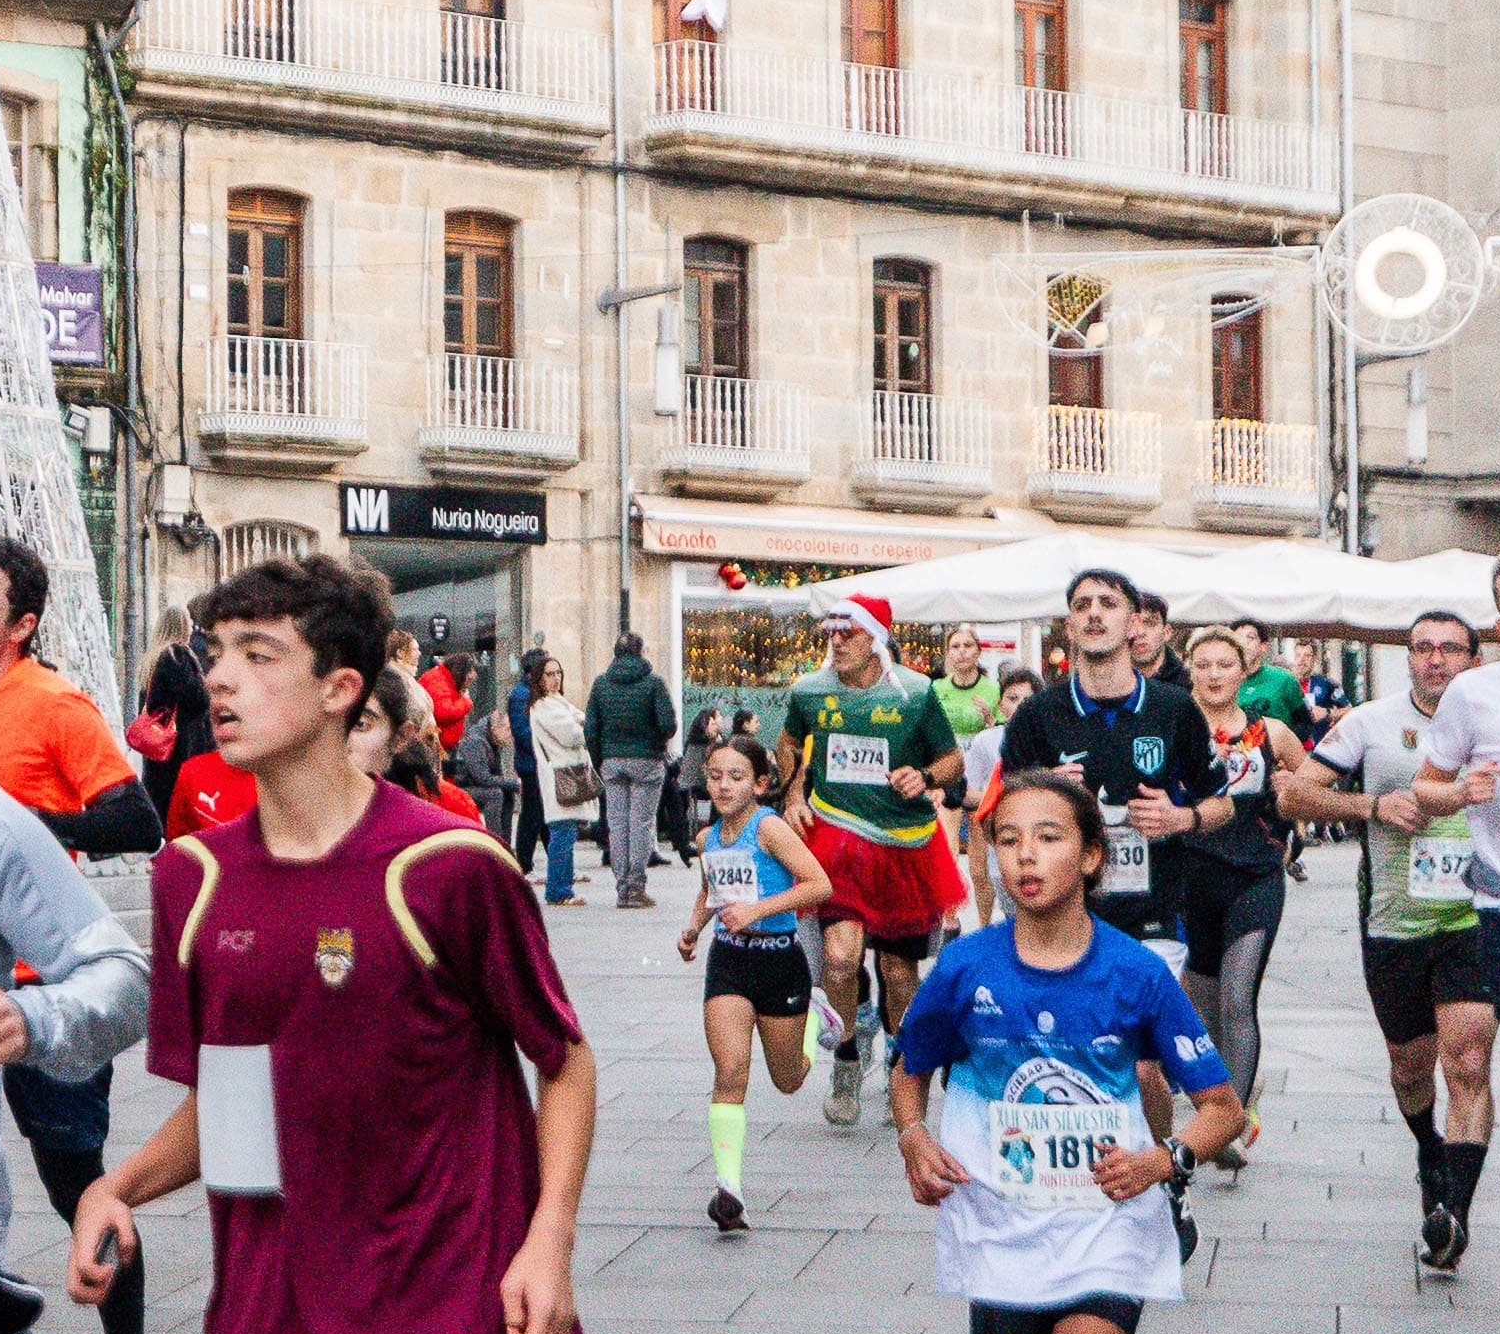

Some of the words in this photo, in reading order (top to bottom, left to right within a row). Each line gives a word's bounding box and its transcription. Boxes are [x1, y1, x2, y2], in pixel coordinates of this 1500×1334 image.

[41, 284, 95, 308] Malvar
[432, 507, 472, 531] Nuria
[474, 509, 540, 537] Nogueira
[852, 748, 885, 765] 3774
[718, 868, 754, 885] 2842
[747, 934, 791, 950] PRO
[1022, 1108, 1050, 1130] SAN
[1053, 1106, 1121, 1132] SILVESTRE
